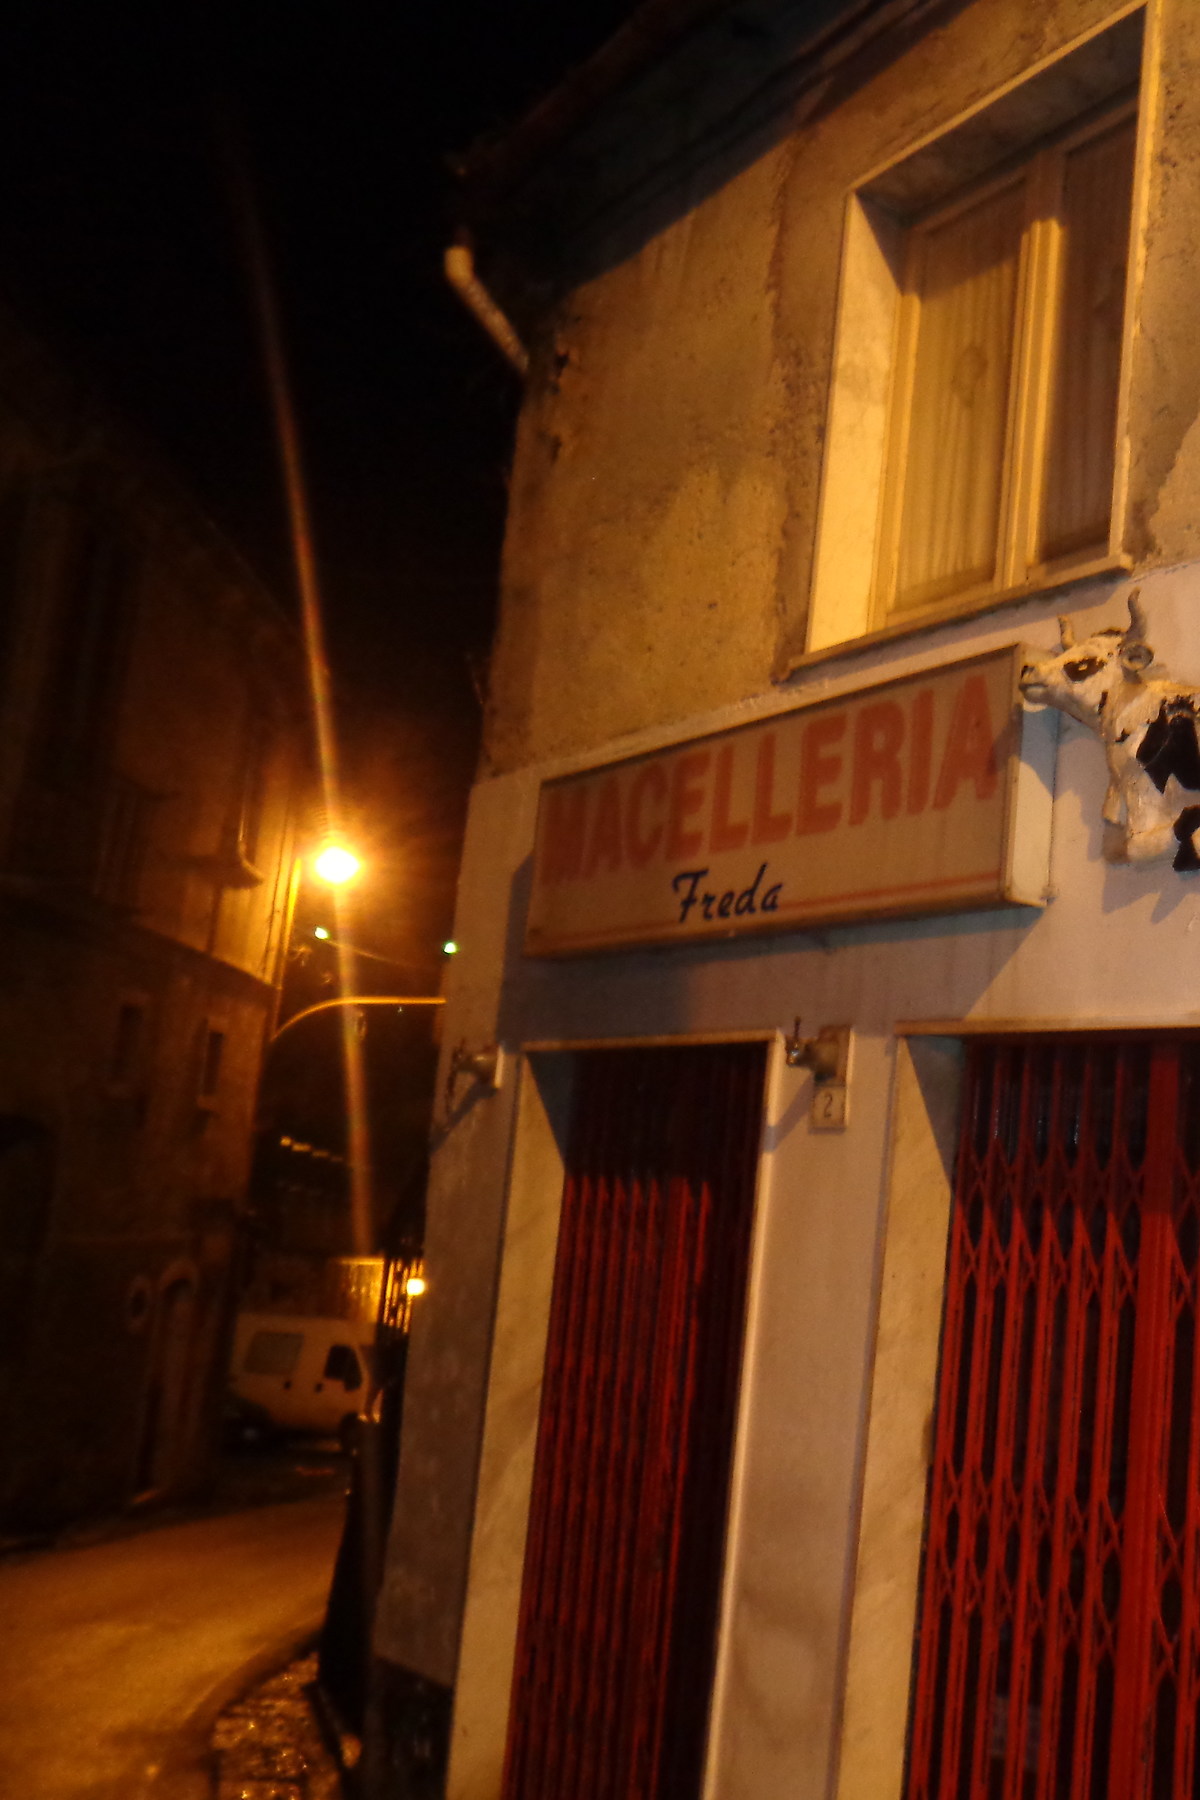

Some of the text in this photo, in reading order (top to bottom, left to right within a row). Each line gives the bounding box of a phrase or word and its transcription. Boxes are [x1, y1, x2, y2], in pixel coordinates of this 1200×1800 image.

[541, 675, 998, 884] MACELLERIA
[671, 863, 783, 922] Freda
[823, 1092, 834, 1118] 2
